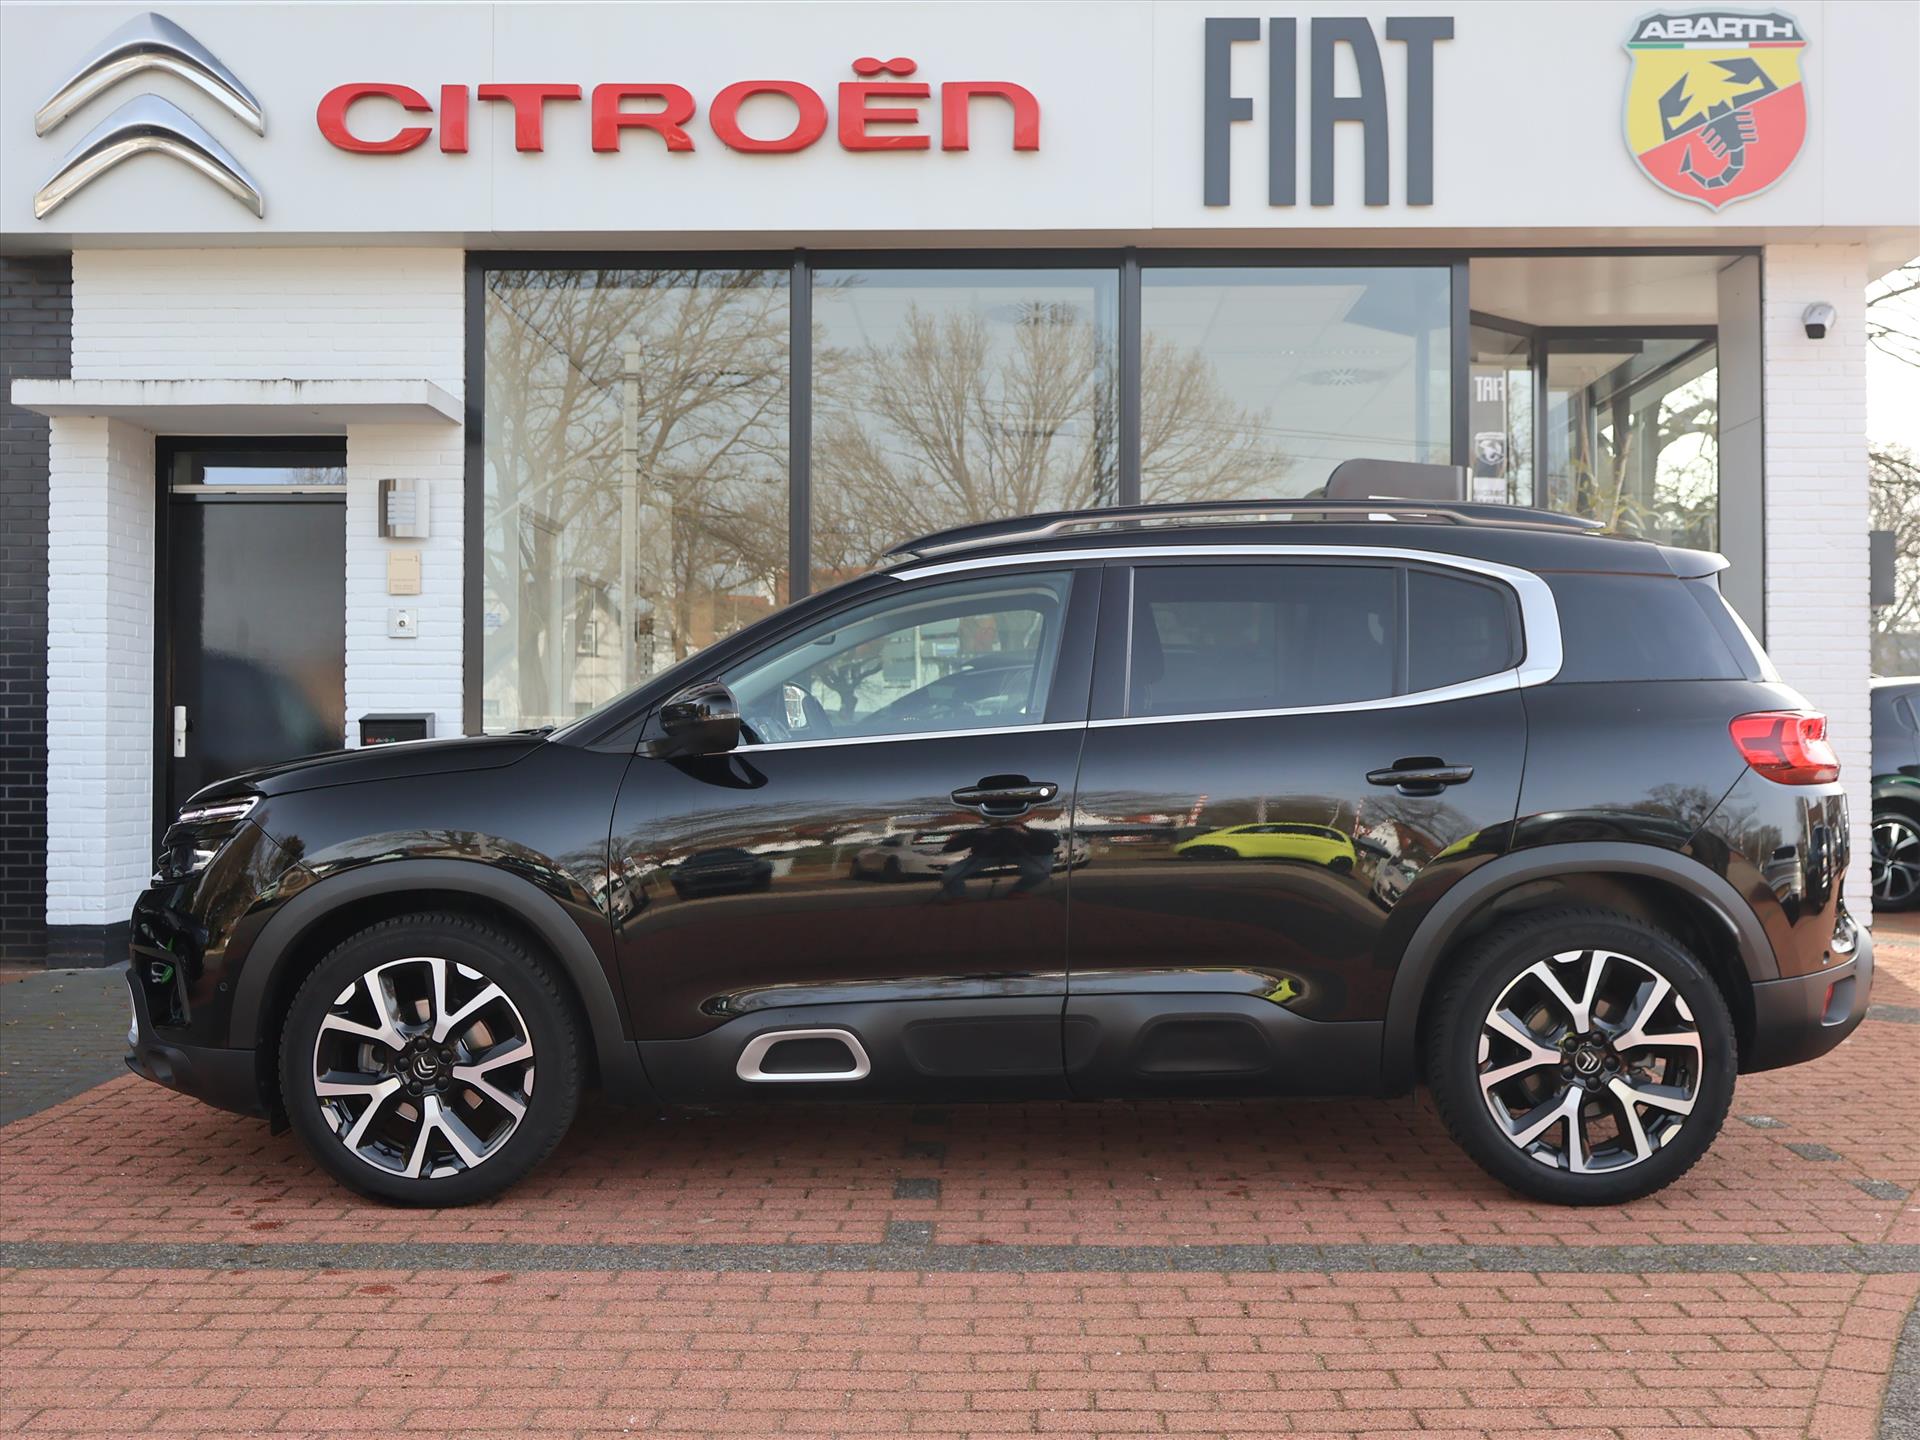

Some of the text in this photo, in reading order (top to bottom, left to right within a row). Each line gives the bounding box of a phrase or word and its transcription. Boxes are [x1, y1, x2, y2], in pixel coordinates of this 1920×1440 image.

[1640, 17, 1793, 39] ABARTH
[317, 57, 1040, 154] CITROËN
[1204, 17, 1454, 206] FIAT
